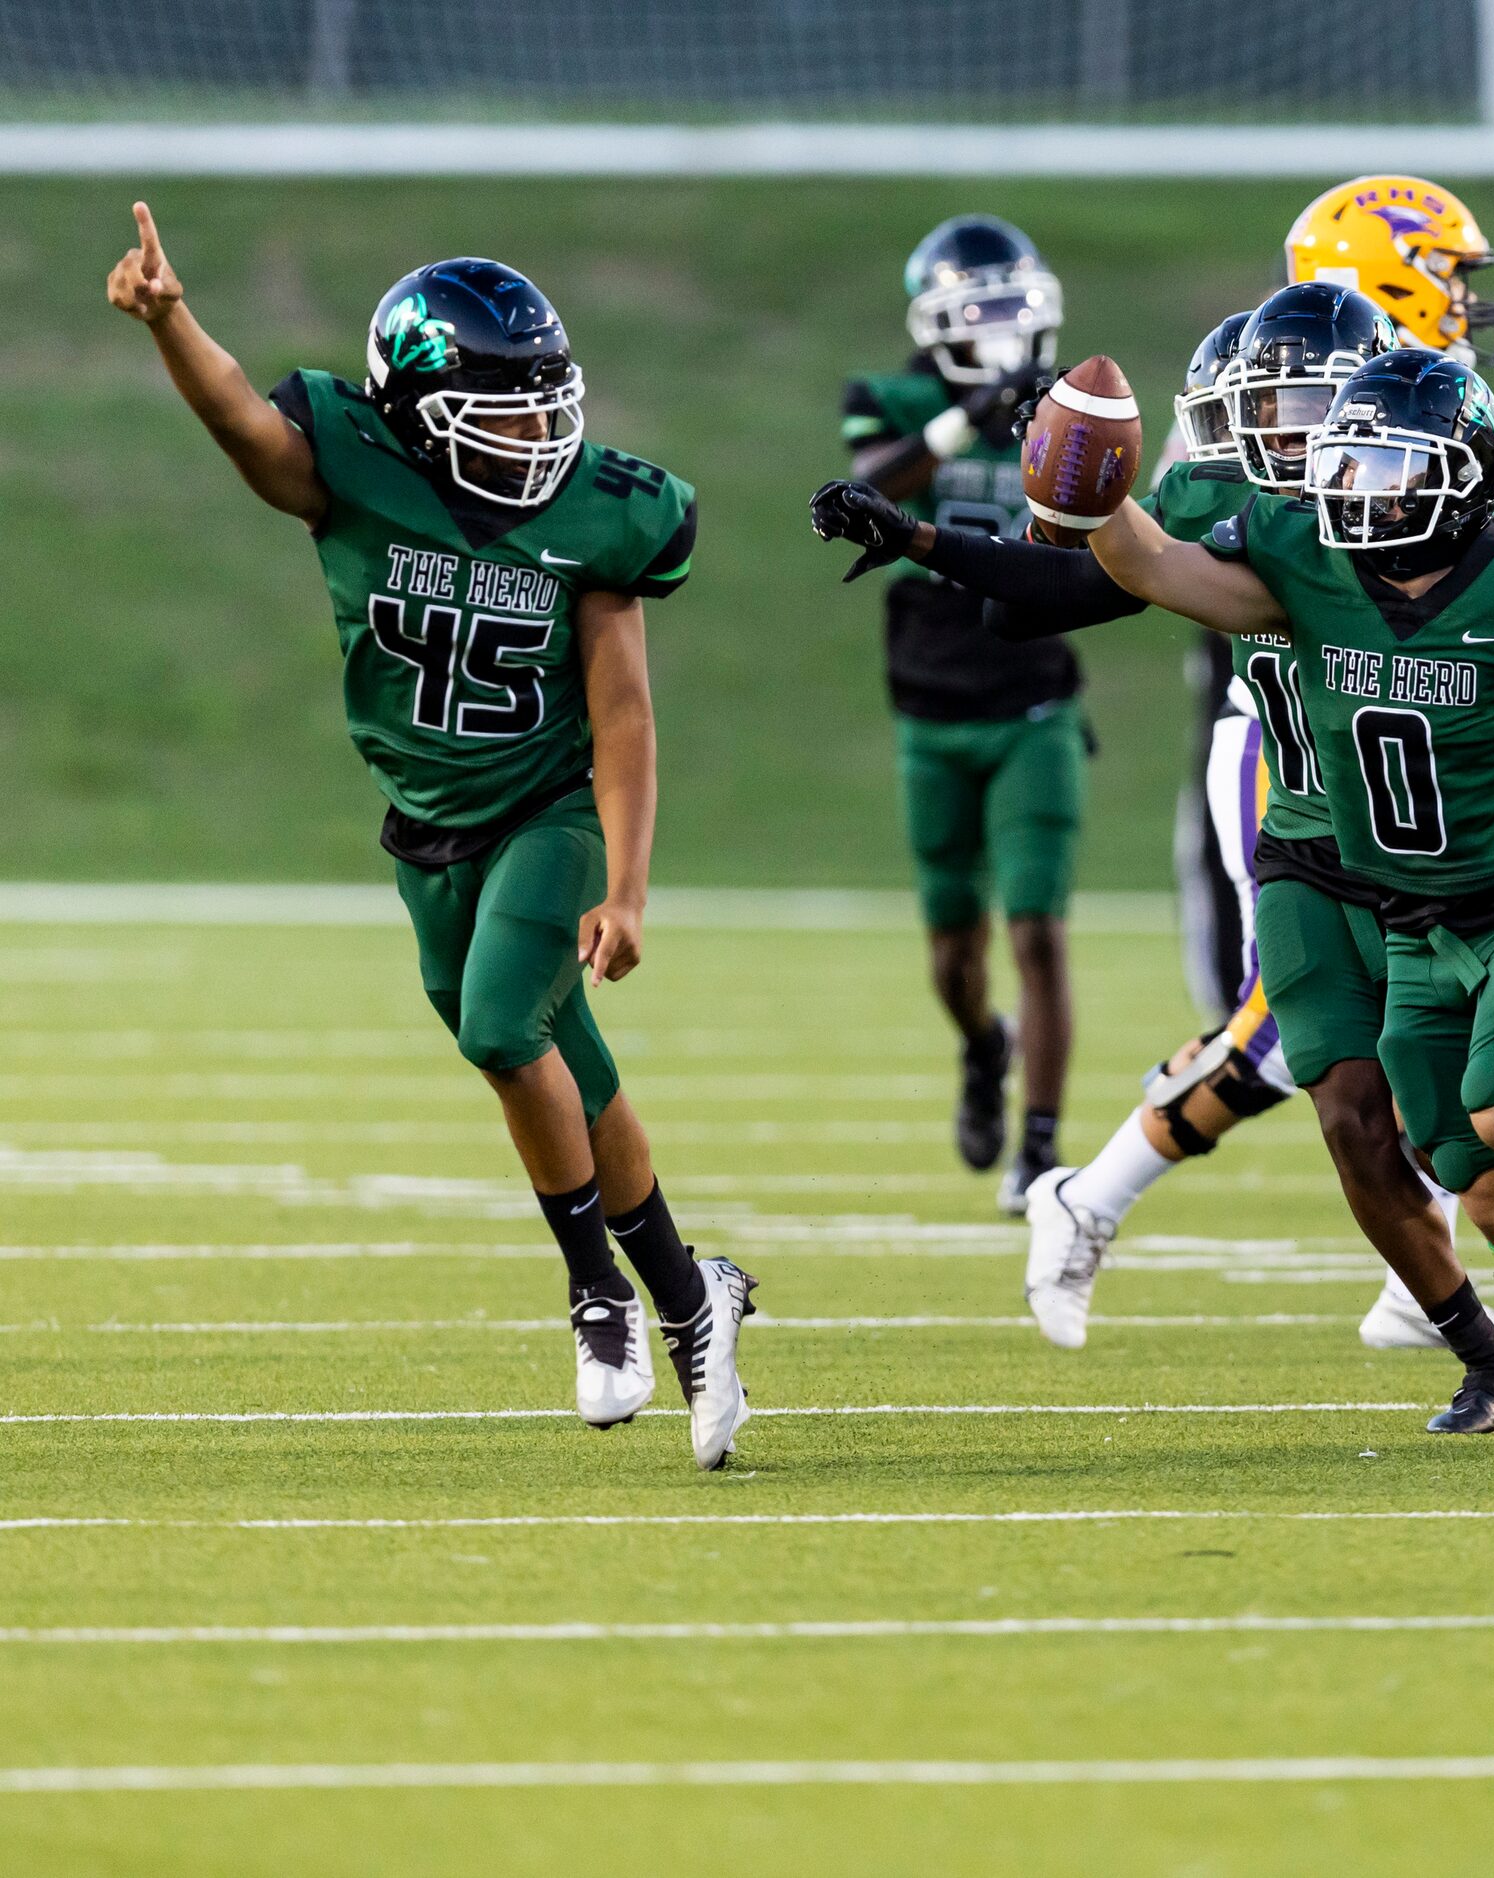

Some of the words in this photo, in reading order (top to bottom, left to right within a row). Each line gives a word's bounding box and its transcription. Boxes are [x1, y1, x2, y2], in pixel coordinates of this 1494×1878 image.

[592, 447, 666, 499] 45
[387, 544, 459, 600] THE
[466, 560, 559, 613] HERD
[368, 593, 555, 738] 45
[1322, 644, 1383, 698] THE
[1389, 655, 1477, 706] HERD
[1248, 651, 1326, 795] 1
[1352, 705, 1447, 856] 0
